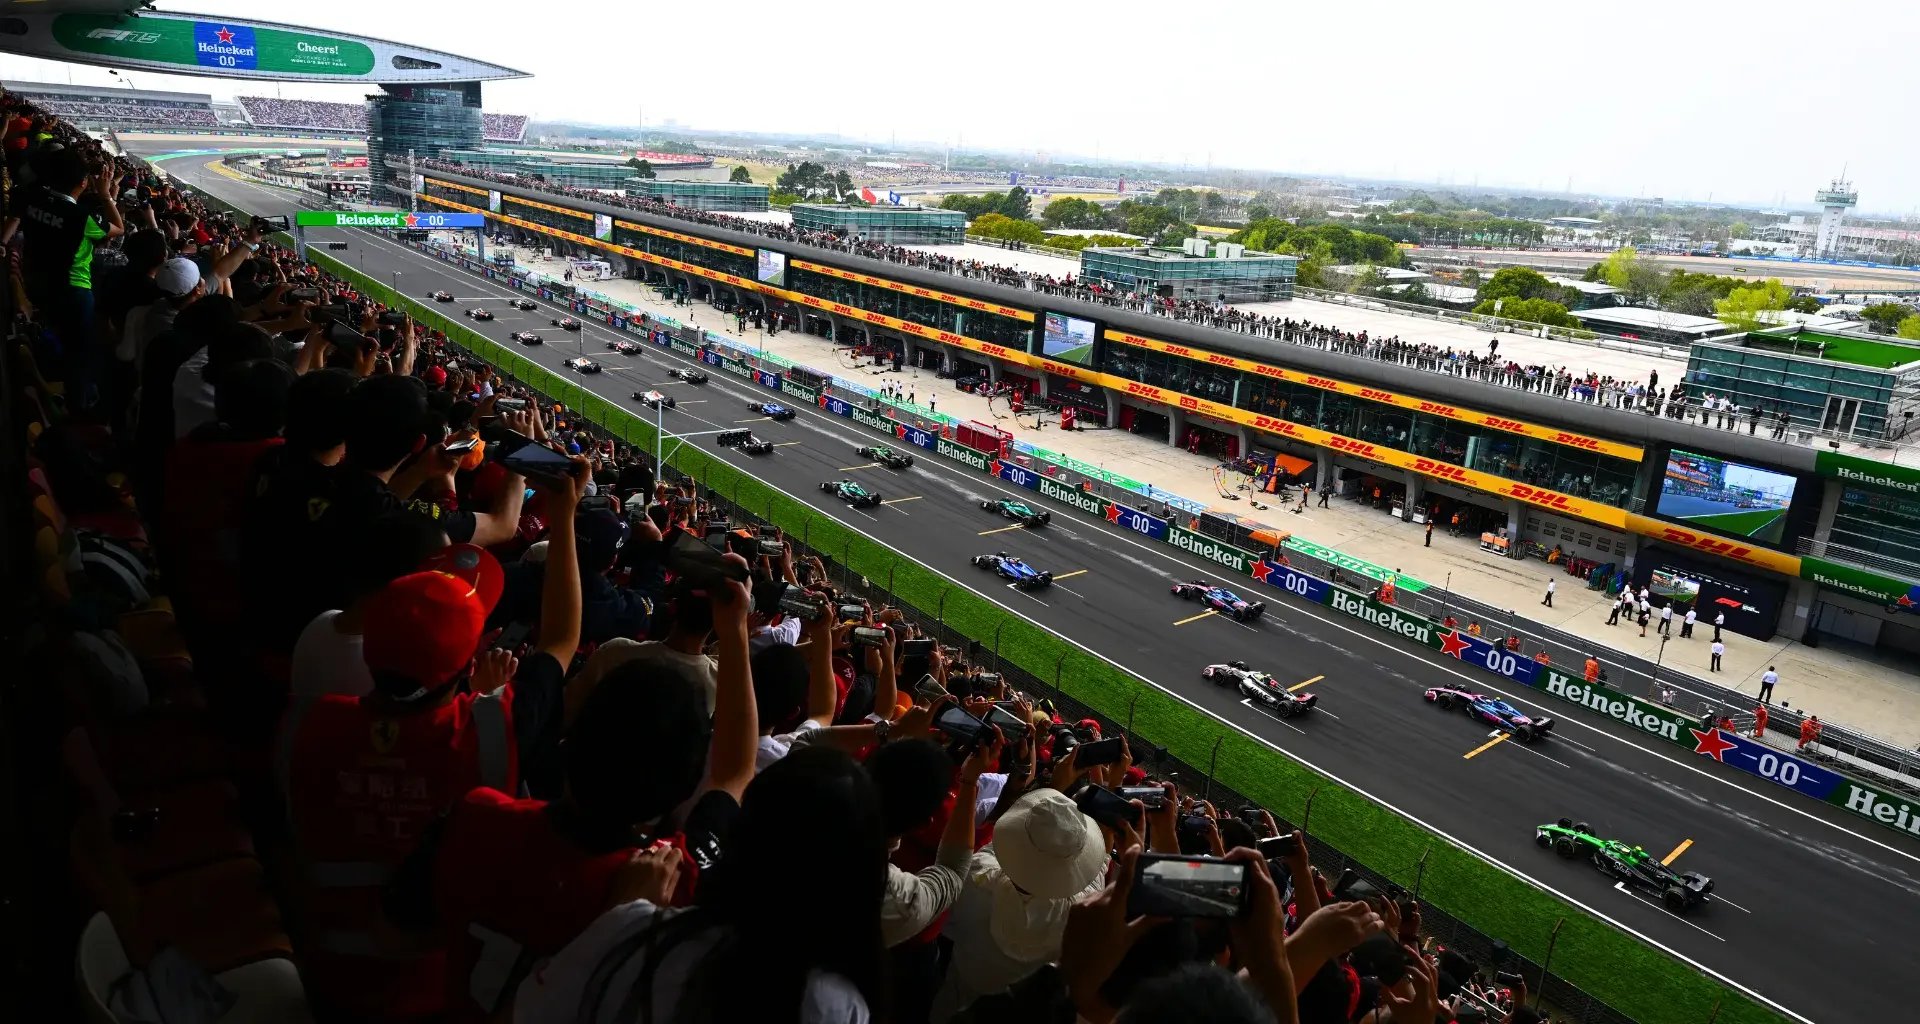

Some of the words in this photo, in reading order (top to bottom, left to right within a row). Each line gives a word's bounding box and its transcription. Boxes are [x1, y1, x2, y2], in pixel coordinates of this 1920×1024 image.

[198, 42, 254, 57] Heineken
[297, 42, 339, 55] Cheers!
[219, 55, 236, 67] 0.0
[26, 206, 65, 229] KICK
[336, 214, 399, 226] Heineken
[428, 215, 443, 226] 0.0
[800, 262, 812, 270] DHL
[821, 267, 833, 275] DHL
[703, 269, 717, 278] DHL
[727, 275, 741, 285] DHL
[843, 272, 856, 280] DHL
[866, 277, 879, 285] DHL
[890, 282, 904, 291] DHL
[915, 288, 930, 297] DHL
[941, 294, 956, 303] DHL
[804, 296, 820, 307] DHL
[969, 300, 985, 309] DHL
[834, 304, 851, 316] DHL
[999, 307, 1017, 317] DHL
[866, 312, 886, 325] DHL
[902, 322, 923, 335] DHL
[940, 333, 963, 346] DHL
[1125, 336, 1147, 347] DHL
[671, 338, 696, 357] Heineken
[982, 343, 1006, 357] DHL
[1166, 345, 1189, 356] DHL
[1210, 354, 1235, 367] DHL
[722, 356, 751, 379] Heineken
[765, 375, 774, 388] 0.0
[1042, 362, 1077, 377] DHL
[1256, 365, 1284, 378] DHL
[1308, 376, 1337, 390] DHL
[782, 380, 815, 404] Heineken
[833, 400, 843, 415] 0.0
[1128, 383, 1161, 400] DHL
[1361, 388, 1393, 403] DHL
[1420, 402, 1455, 417] DHL
[852, 406, 892, 434] Heineken
[913, 430, 925, 446] 0.0
[1255, 415, 1297, 437] DHL
[1485, 417, 1525, 433] DHL
[1329, 435, 1376, 458] DHL
[1557, 433, 1599, 450] DHL
[937, 438, 985, 470] Heineken
[1011, 468, 1025, 485] 0.0
[1414, 458, 1467, 483] DHL
[1837, 466, 1919, 493] Heineken
[1510, 484, 1571, 510] DHL
[1040, 477, 1098, 515] Heineken
[1132, 514, 1149, 534] 0.0
[1662, 527, 1756, 564] DHL
[1168, 526, 1243, 571] Heineken
[1285, 572, 1308, 596] 0.0
[1813, 572, 1888, 602] Heineken
[1330, 589, 1430, 644] Heineken
[1486, 649, 1516, 676] 0.0
[1545, 671, 1679, 742] Heineken
[1758, 753, 1800, 786] 0.0
